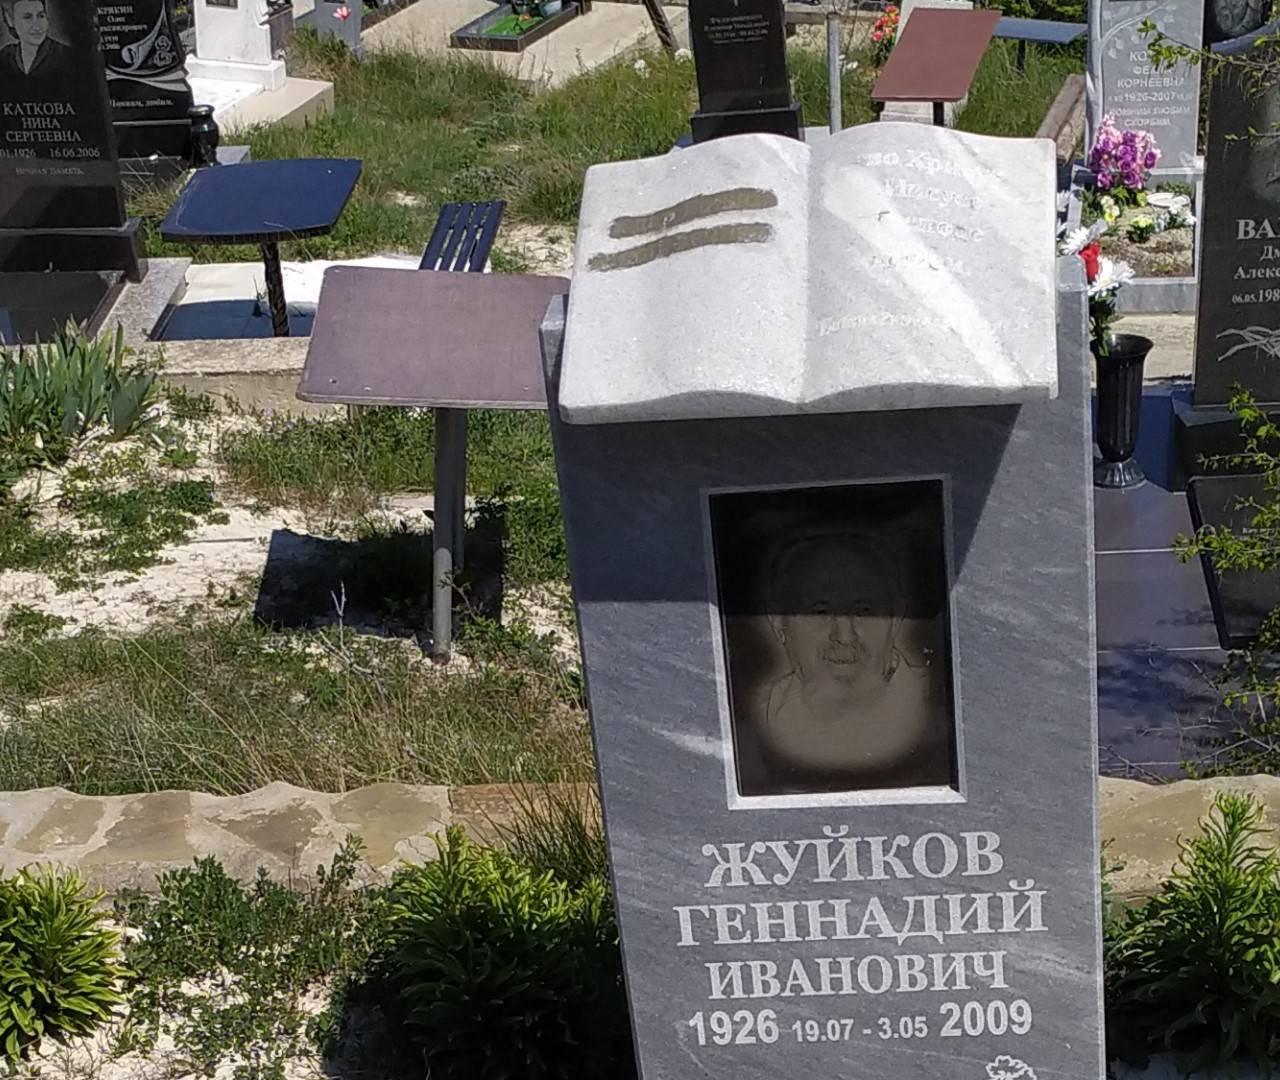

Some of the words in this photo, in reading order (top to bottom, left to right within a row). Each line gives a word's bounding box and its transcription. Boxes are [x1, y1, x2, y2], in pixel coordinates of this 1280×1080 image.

[3, 103, 75, 116] КАТКОВА
[22, 117, 61, 130] НИНА
[6, 131, 82, 143] СЕРГЕЕВНА
[700, 824, 1004, 888] ЖУЙКОВ
[673, 878, 1049, 947] ГЕННАДИЙ
[705, 950, 1010, 1000] ИВАНОВИЧ
[688, 1008, 780, 1046] 1926
[792, 1018, 854, 1043] 19.07
[878, 1016, 929, 1040] 3.05
[939, 999, 1034, 1038] 2009
